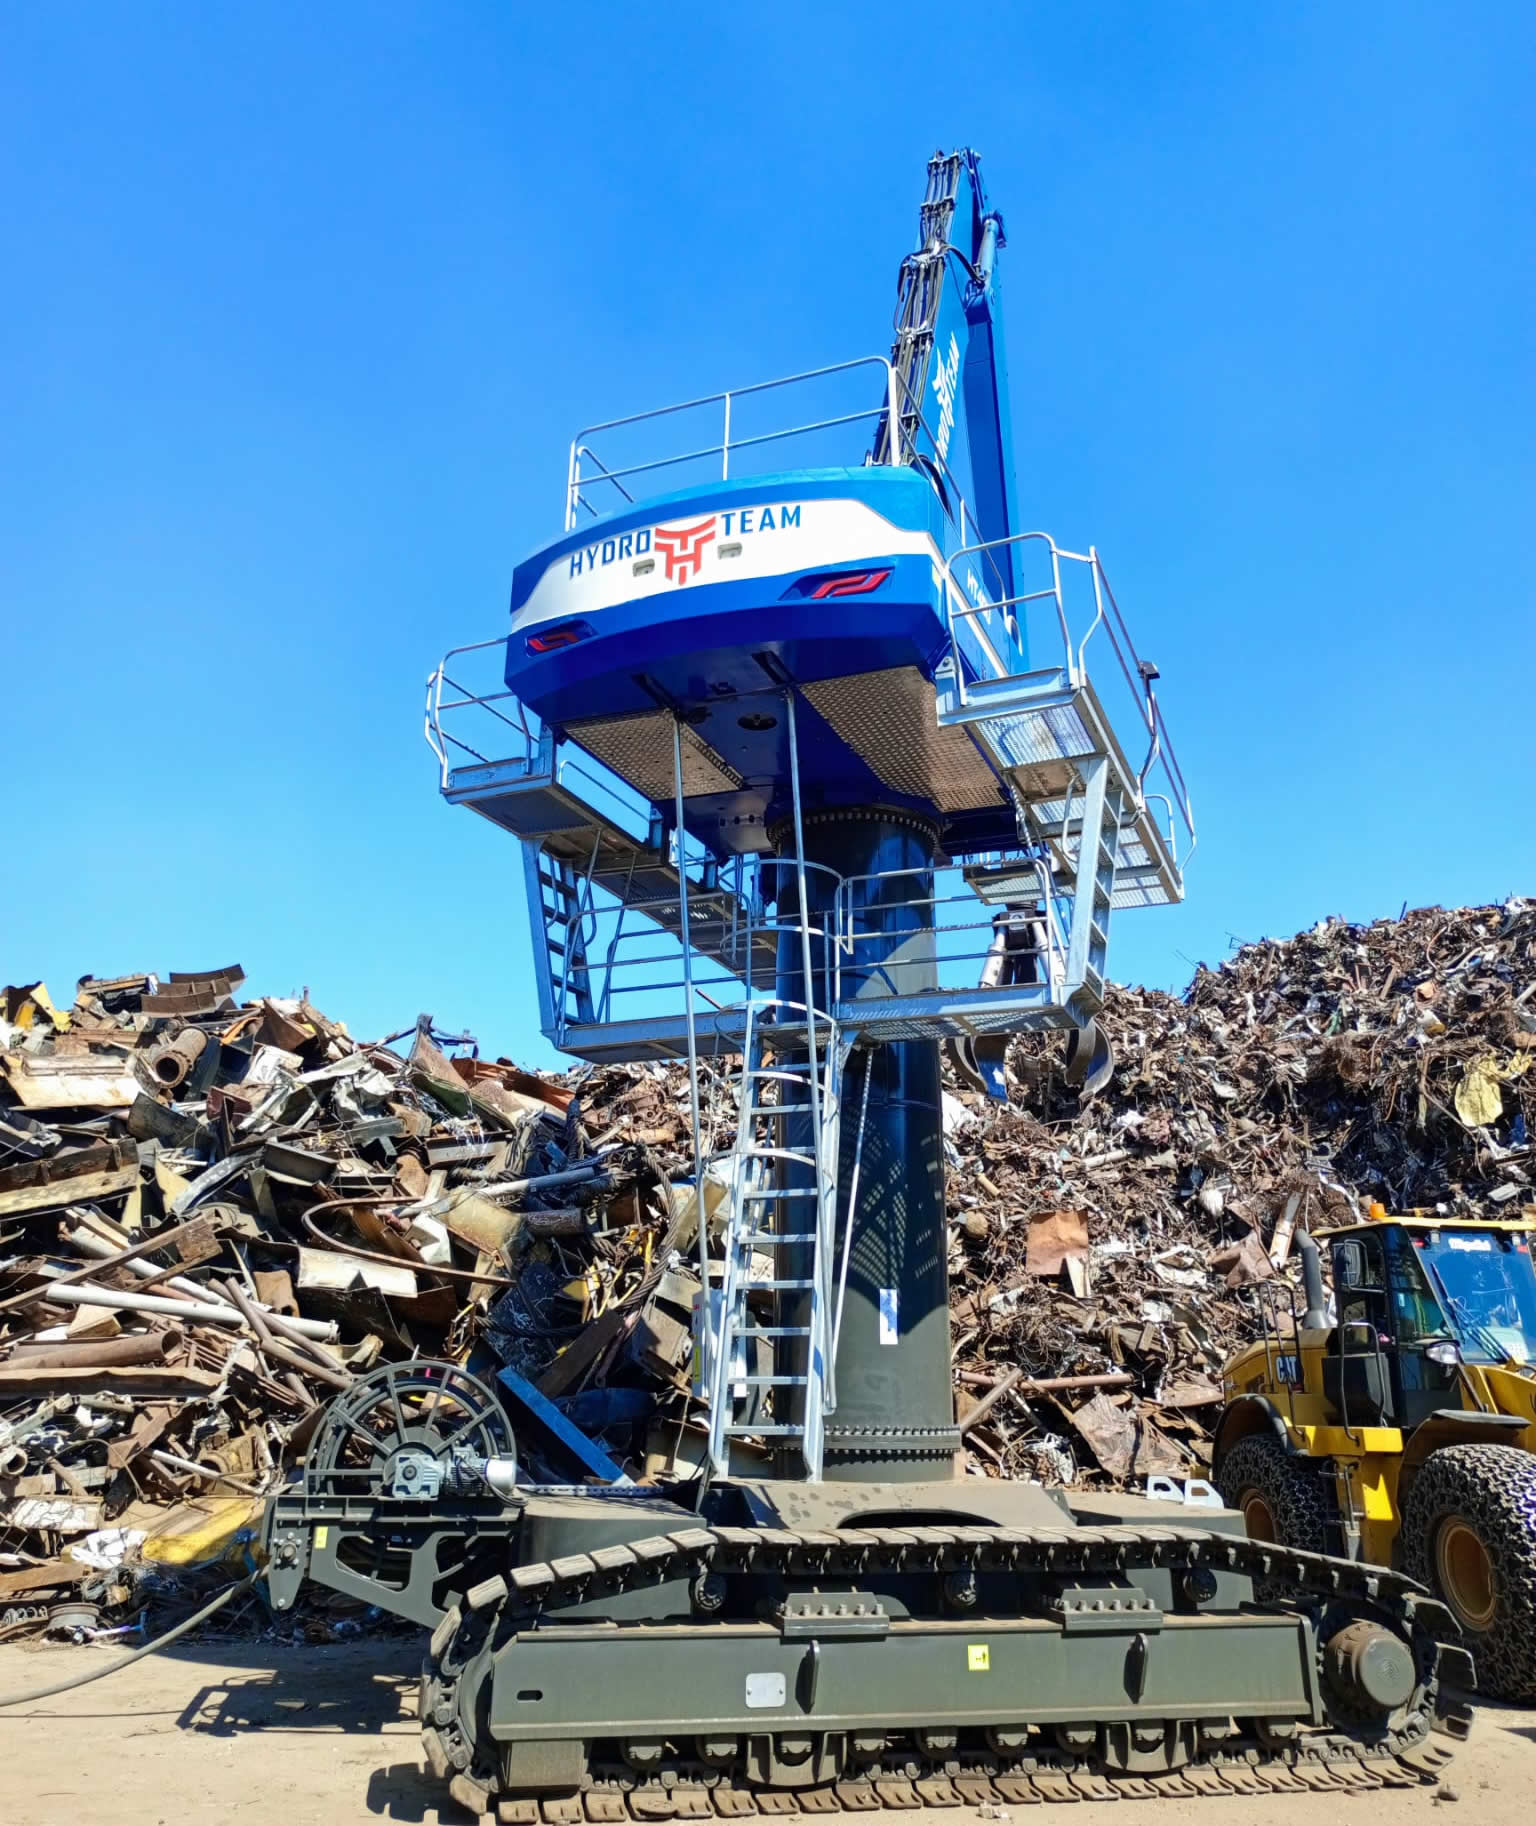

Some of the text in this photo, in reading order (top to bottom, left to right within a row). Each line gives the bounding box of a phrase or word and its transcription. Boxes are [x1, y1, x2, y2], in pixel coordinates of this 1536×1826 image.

[570, 530, 652, 580] HYDRO
[721, 505, 801, 536] TEAM
[1276, 1355, 1297, 1383] CAT
